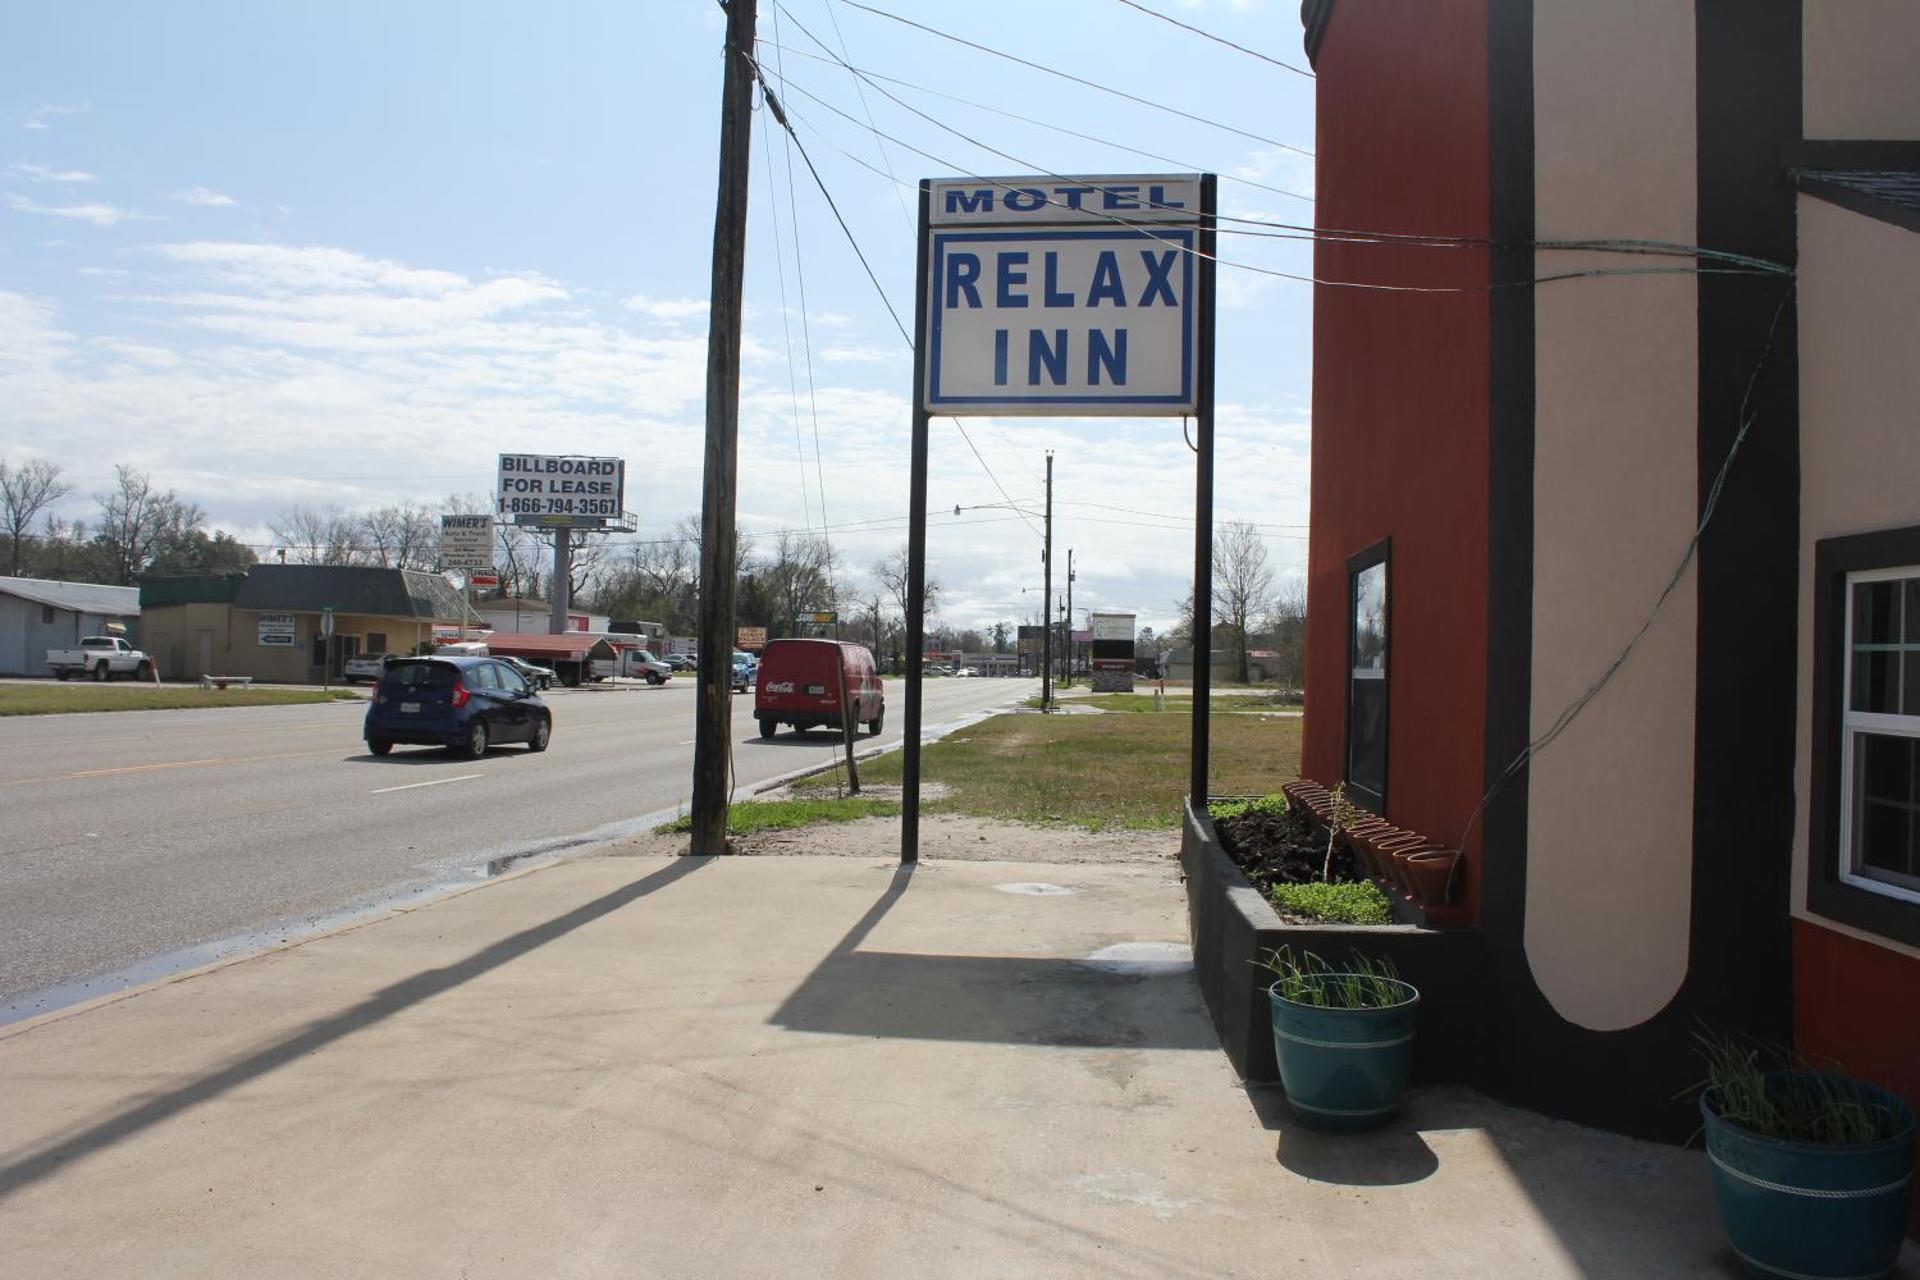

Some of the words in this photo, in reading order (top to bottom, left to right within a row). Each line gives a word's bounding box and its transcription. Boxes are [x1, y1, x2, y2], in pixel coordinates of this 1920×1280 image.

[945, 185, 1185, 213] MOTEL
[945, 250, 1179, 309] RELAX
[994, 328, 1128, 386] INN
[502, 457, 615, 475] BILLBOARD
[502, 478, 543, 493] FOR
[549, 480, 612, 495] LEASE
[499, 497, 616, 514] 1-866-794-3567
